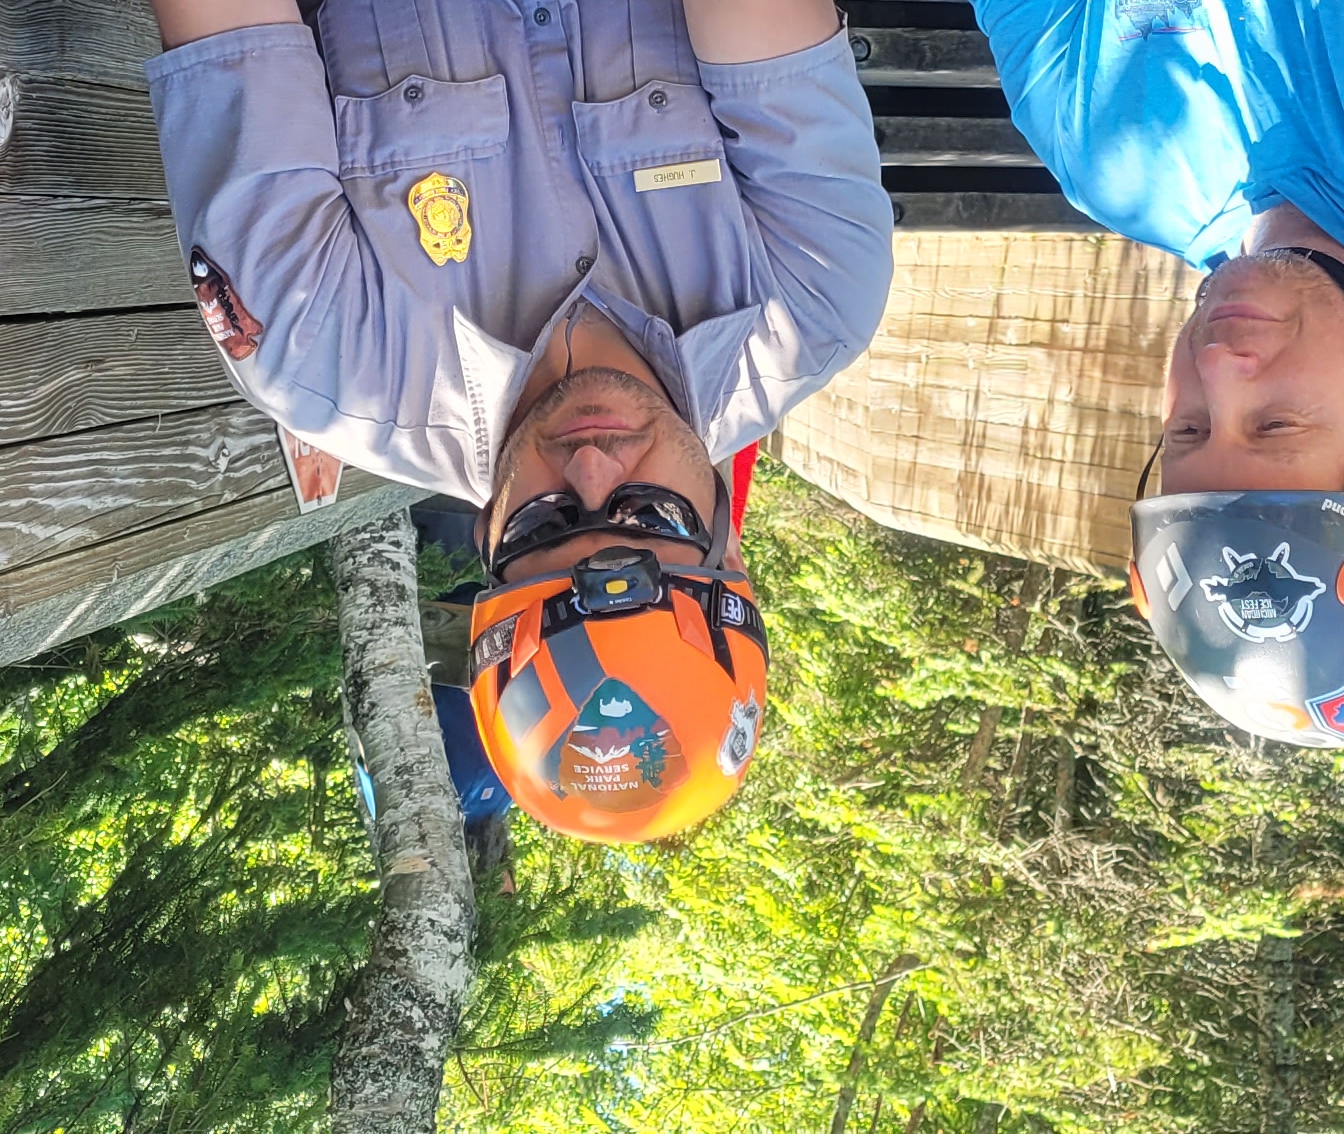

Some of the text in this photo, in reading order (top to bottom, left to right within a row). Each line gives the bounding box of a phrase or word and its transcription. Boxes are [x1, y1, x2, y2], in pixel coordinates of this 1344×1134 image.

[653, 169, 696, 183] J. HUGHES
[721, 595, 742, 622] PET
[1240, 598, 1273, 610] ICE FEST
[573, 764, 630, 774] SERVICE
[585, 774, 621, 783] PARK
[569, 781, 639, 792] NATIONAL
